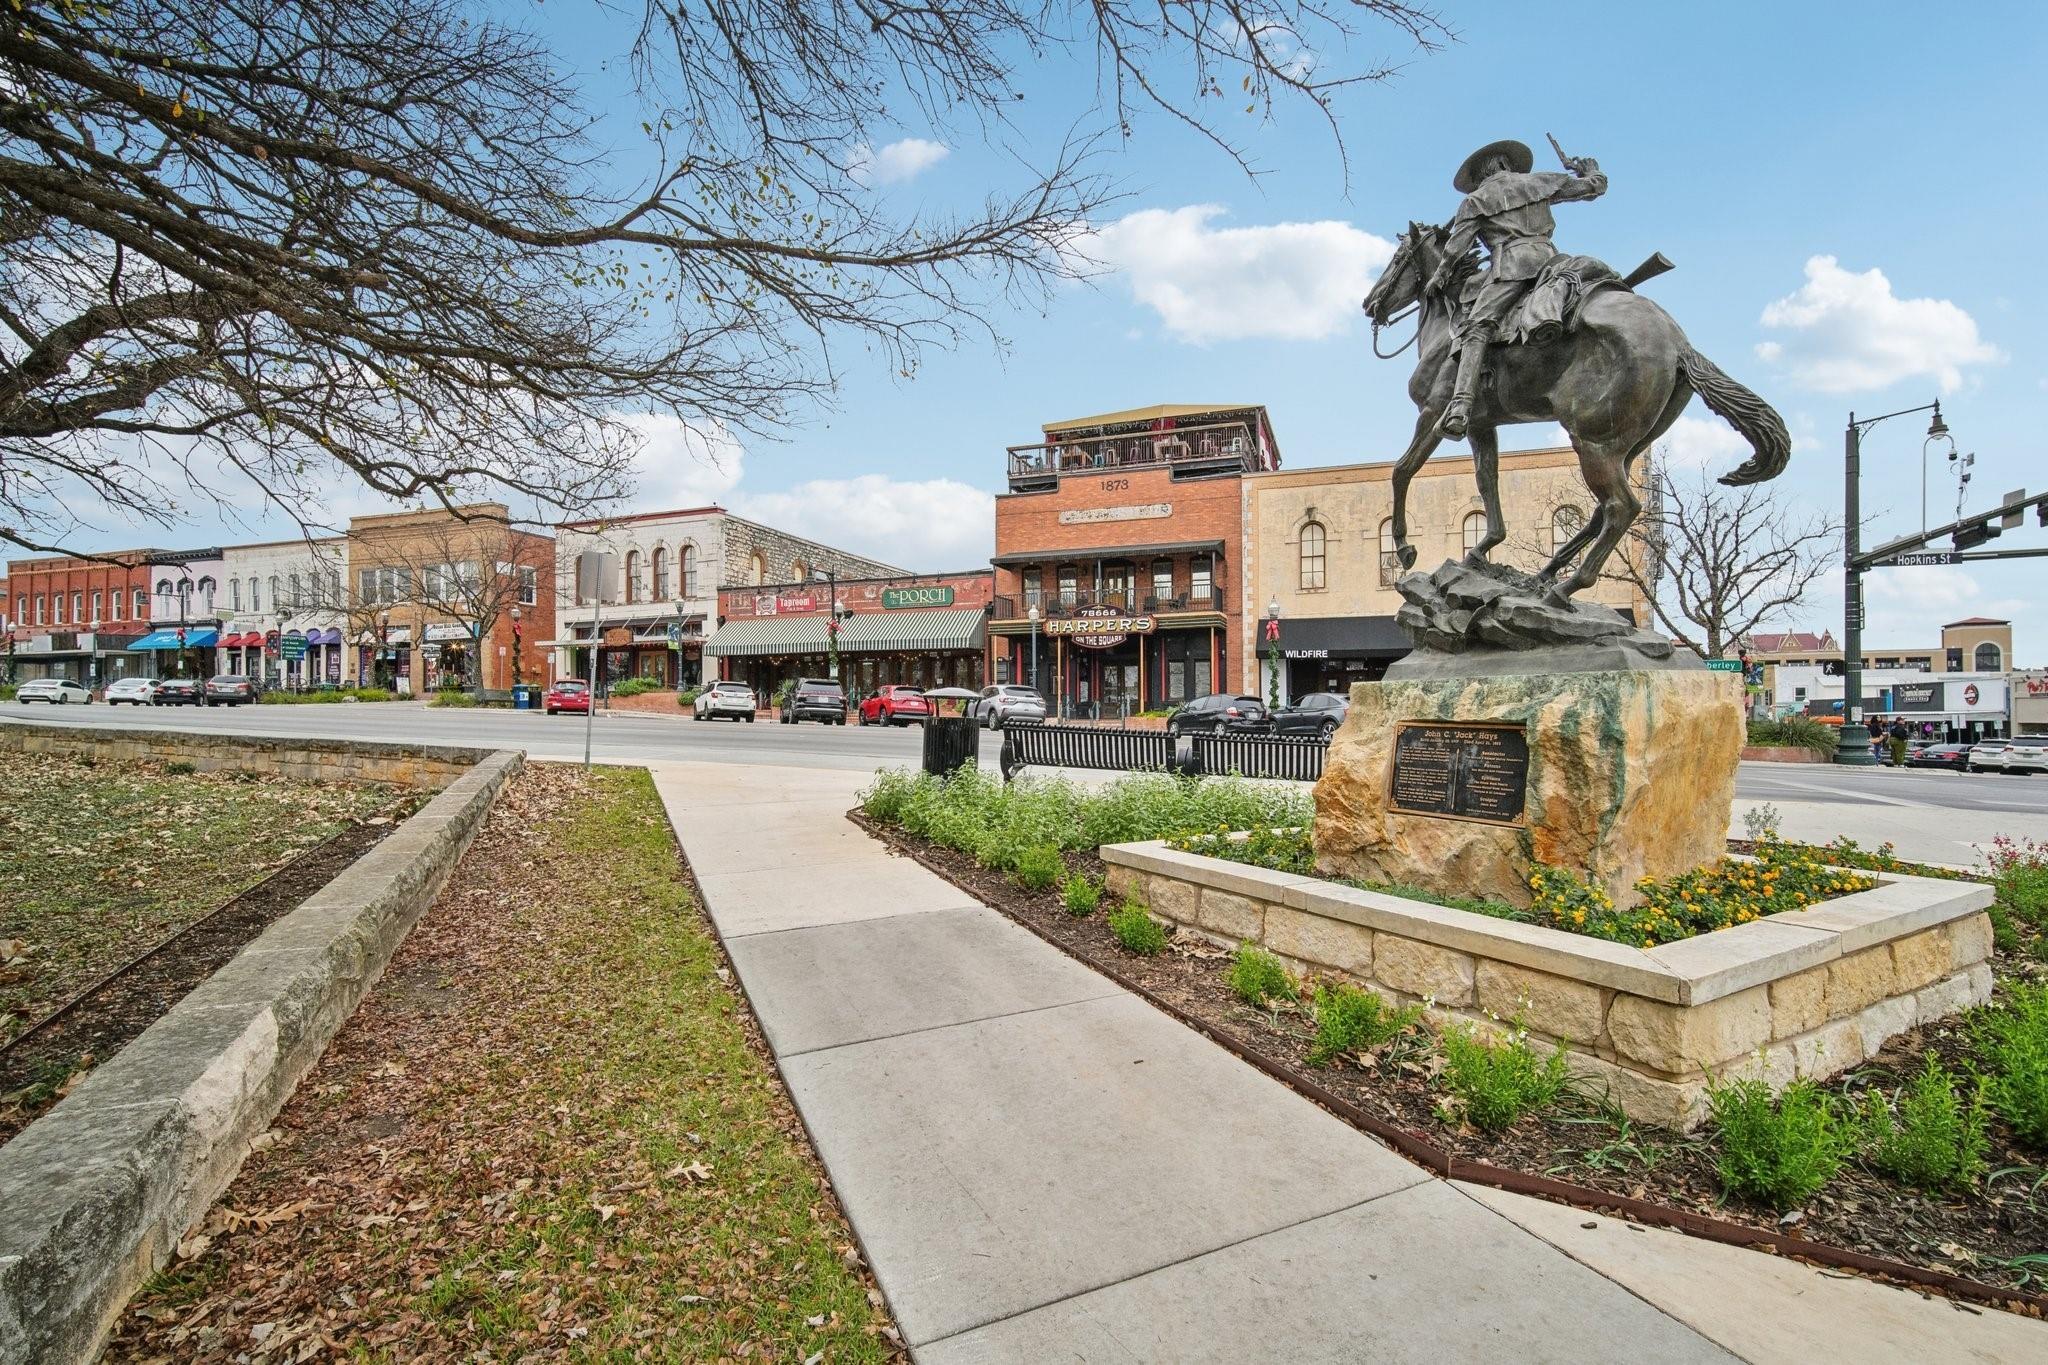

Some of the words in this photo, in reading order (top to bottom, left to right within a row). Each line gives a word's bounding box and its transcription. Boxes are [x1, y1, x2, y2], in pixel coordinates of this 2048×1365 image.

[1101, 480, 1129, 491] 1873
[1897, 554, 1937, 566] Hopkins
[1940, 553, 1951, 564] St
[900, 588, 946, 603] PORCH
[780, 596, 810, 608] Taproom
[1048, 618, 1151, 633] HARPER'S
[1075, 636, 1085, 644] ON
[1085, 636, 1098, 645] THE
[1098, 635, 1123, 646] SQUARE
[1285, 649, 1328, 658] WILDFIRE
[1479, 732, 1498, 740] Hays
